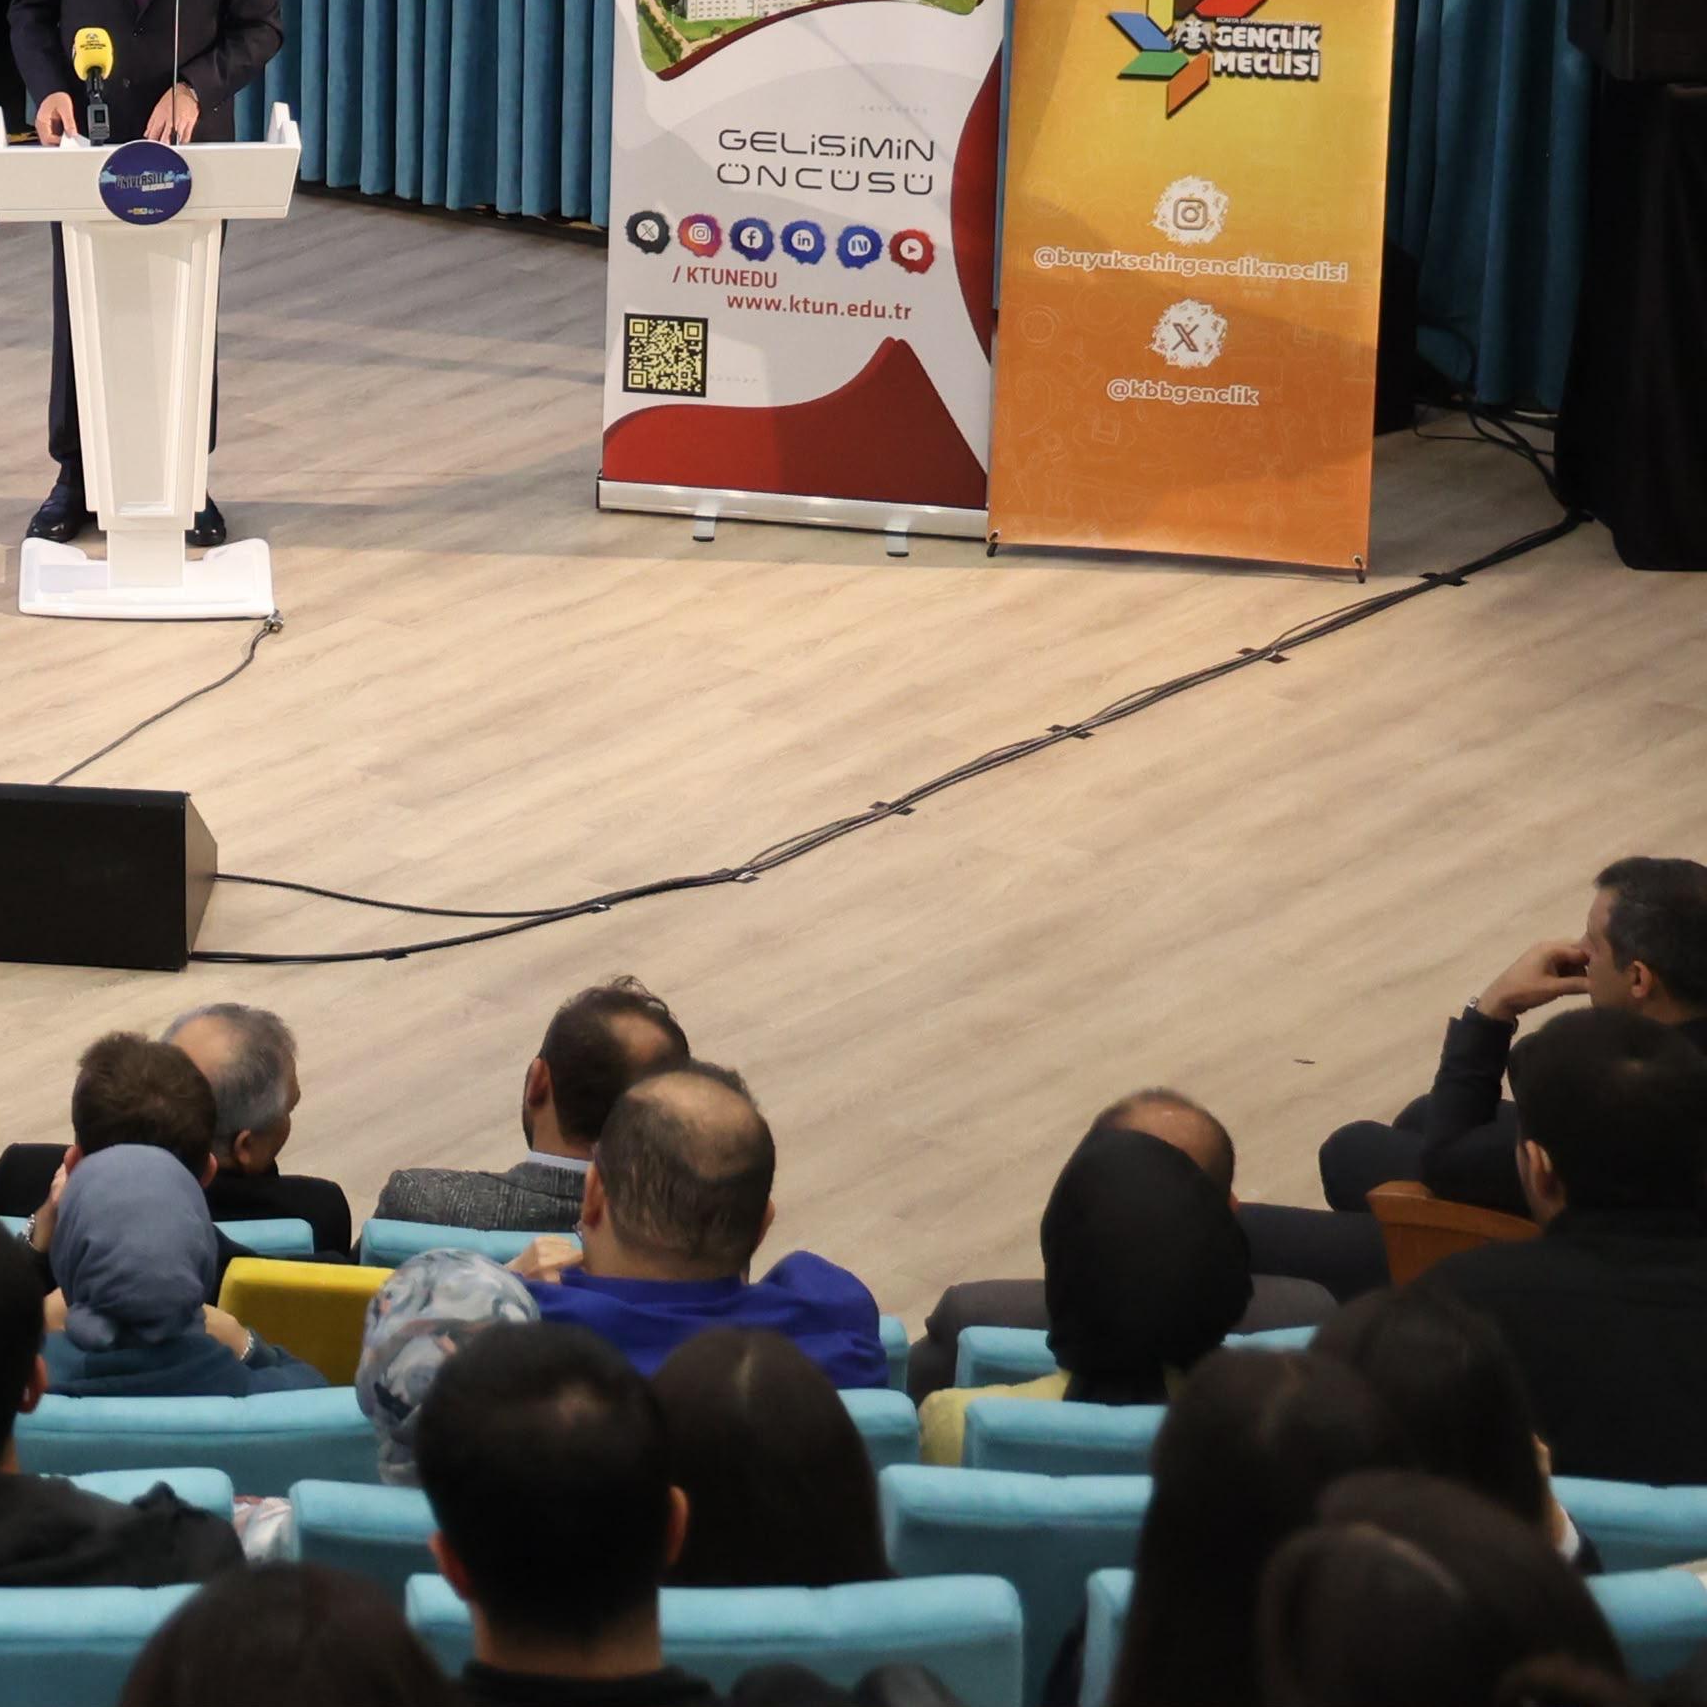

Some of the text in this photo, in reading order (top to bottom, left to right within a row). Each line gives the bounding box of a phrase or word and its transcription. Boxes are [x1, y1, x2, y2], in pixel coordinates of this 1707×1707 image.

[1215, 25, 1320, 52] GENÇLİK
[1213, 51, 1320, 77] MECLİSİ
[717, 163, 933, 195] ÖNCÜSÜ
[687, 266, 778, 289] KTUNEDU
[1034, 247, 1348, 282] @buyuksehirgenclikmeclisi
[726, 295, 912, 320] www.ktun.edu.tr
[1107, 379, 1259, 405] @kbbgenclik
